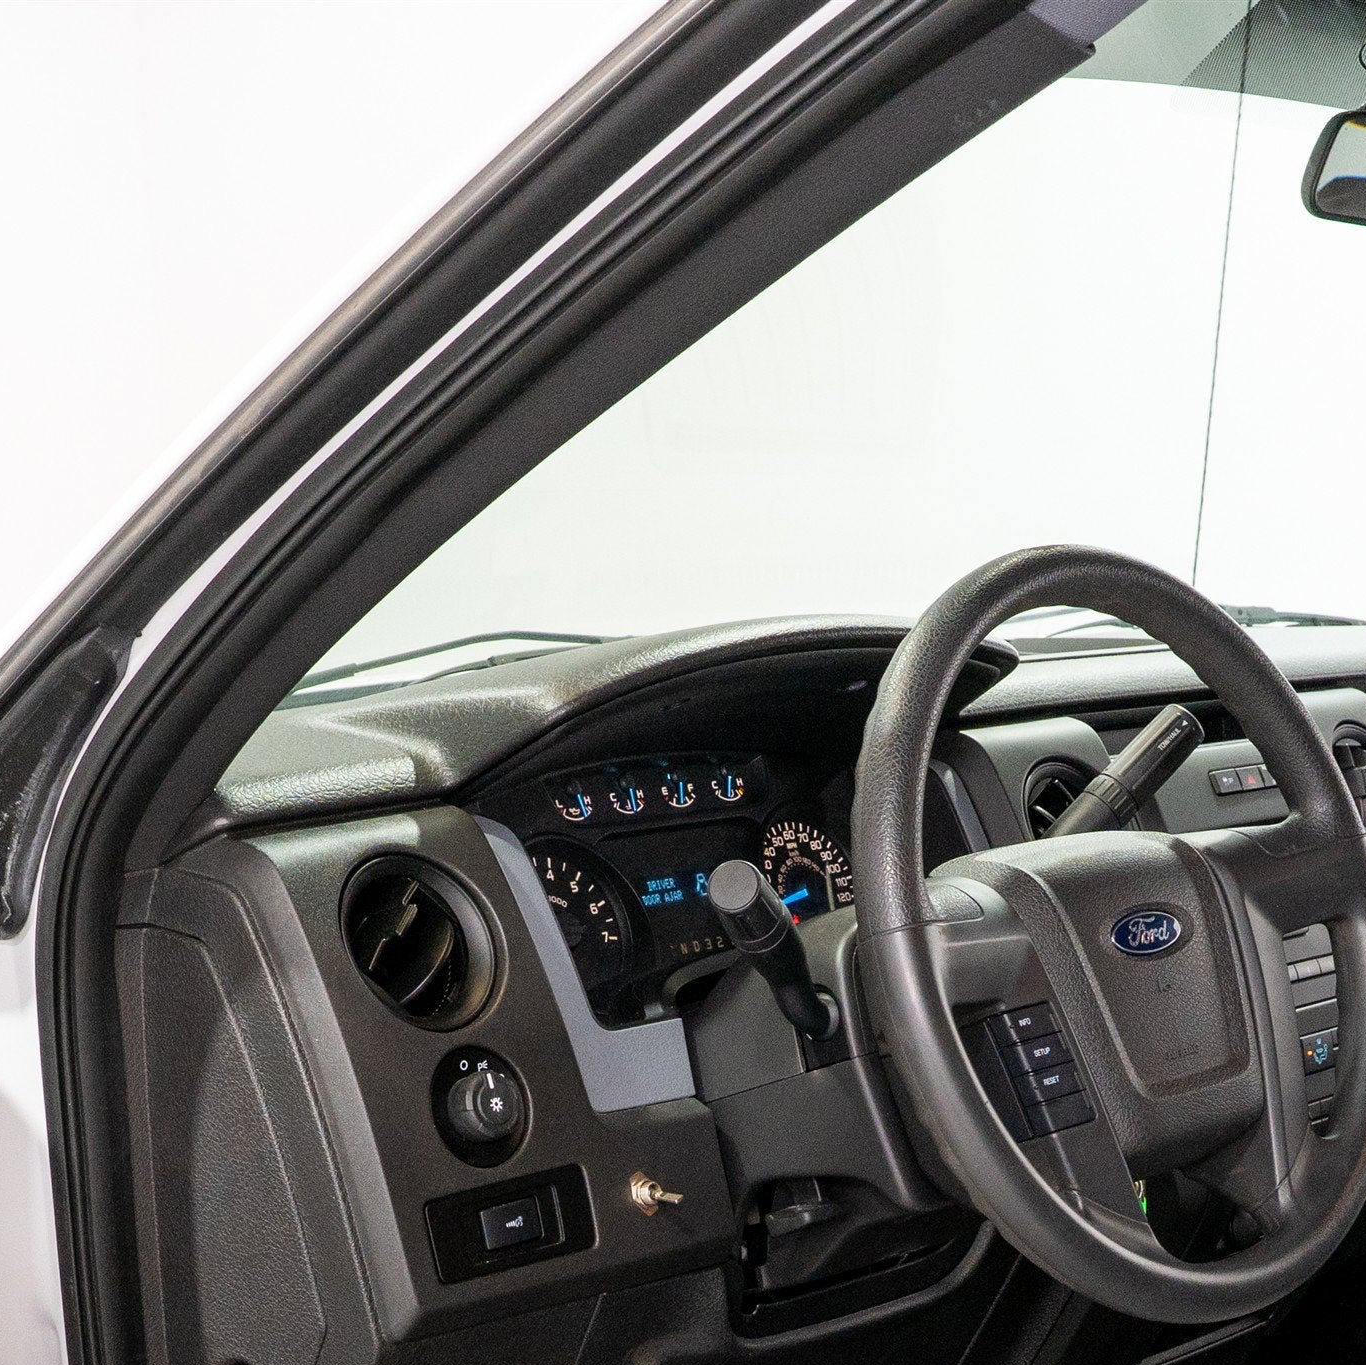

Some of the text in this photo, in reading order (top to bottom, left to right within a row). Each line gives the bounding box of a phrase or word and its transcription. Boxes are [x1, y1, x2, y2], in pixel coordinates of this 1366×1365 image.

[711, 780, 719, 789] C
[736, 777, 744, 786] H
[661, 786, 669, 796] E
[687, 783, 695, 792] F
[609, 793, 617, 802] C
[636, 789, 645, 798] H
[555, 800, 564, 808] L
[583, 795, 592, 805] H
[782, 830, 795, 841] 60
[797, 833, 809, 843] 70
[772, 837, 784, 847] 50
[809, 840, 822, 851] 80
[764, 847, 776, 857] 40
[820, 850, 833, 862] 90
[827, 864, 841, 874] 100
[546, 869, 555, 881] 4
[569, 881, 579, 893] 5
[646, 877, 676, 892] DRIVER
[836, 877, 848, 887] 110
[641, 889, 684, 906] DOOR AJAR
[837, 892, 851, 902] 120
[589, 902, 599, 915] 6
[1128, 915, 1170, 947] Ford
[601, 931, 609, 943] 7
[680, 943, 689, 955] N
[704, 938, 713, 950] 3
[716, 936, 725, 948] 2
[1033, 1046, 1051, 1058] SETUP
[1043, 1075, 1060, 1086] RESET
